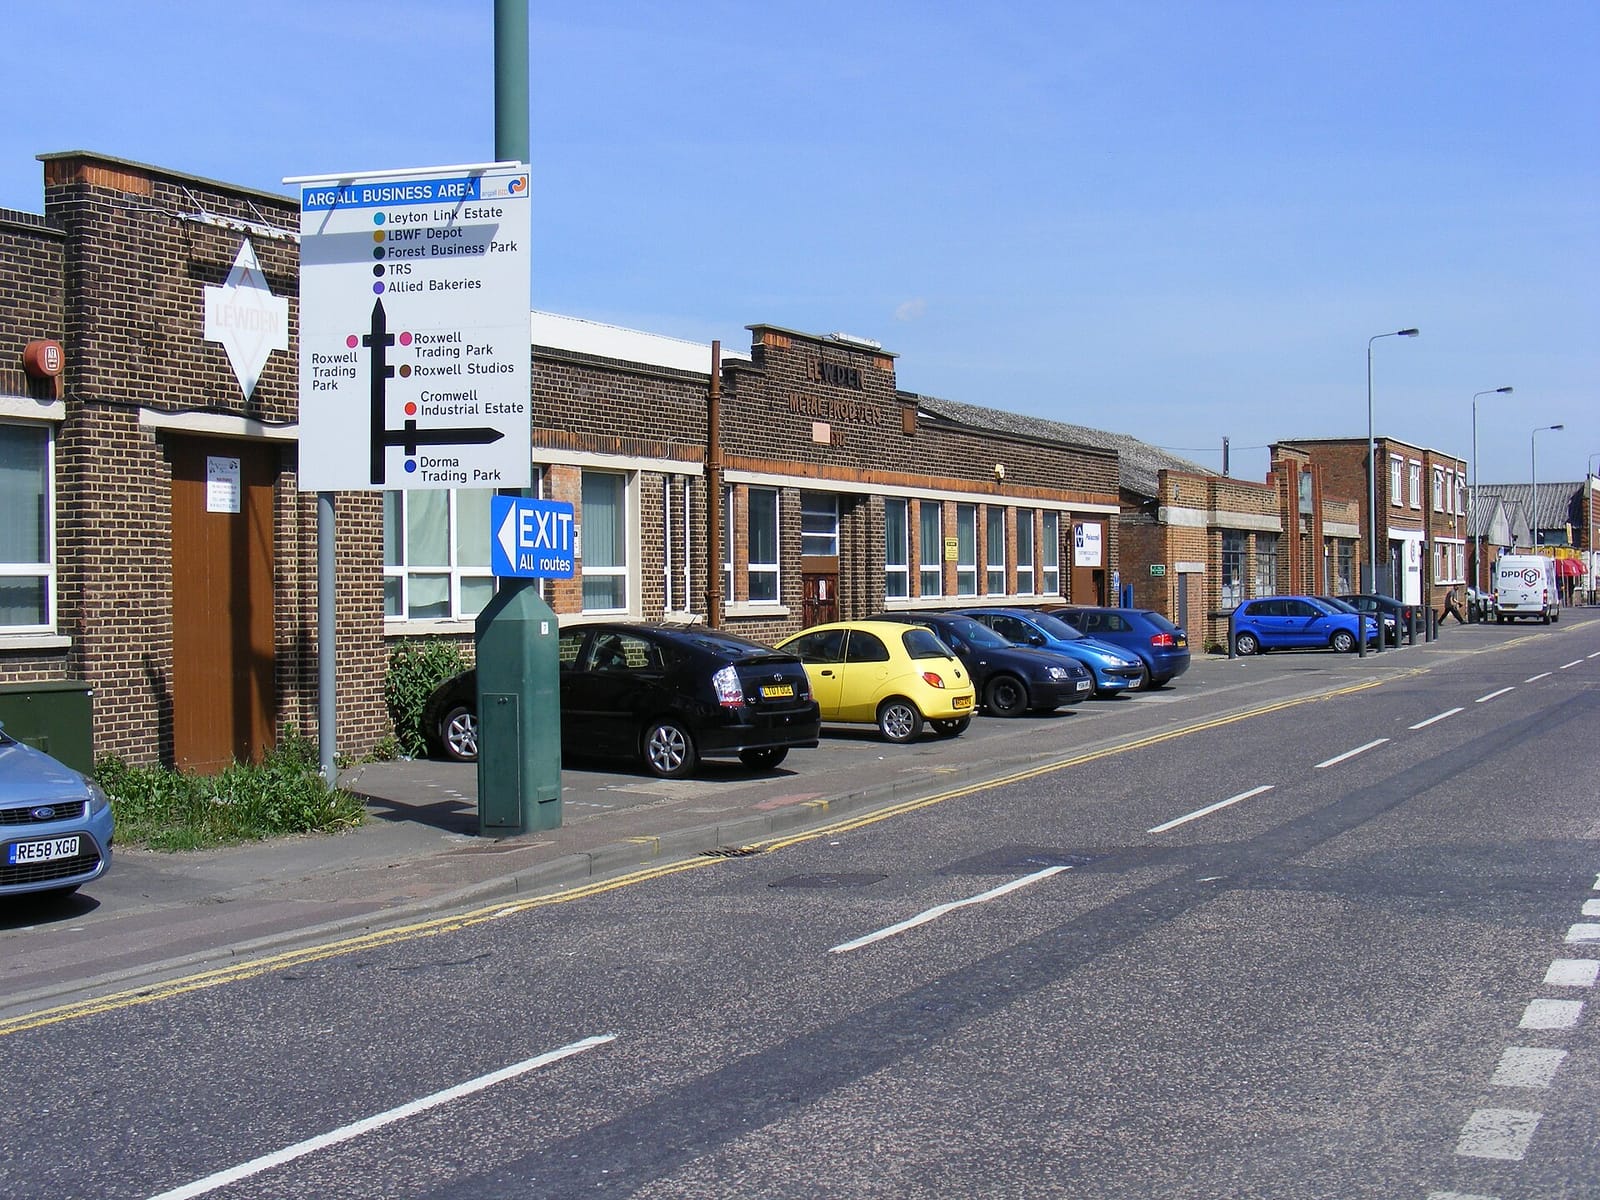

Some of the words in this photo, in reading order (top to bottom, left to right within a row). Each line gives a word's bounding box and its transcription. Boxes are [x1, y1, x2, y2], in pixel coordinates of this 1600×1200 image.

[307, 188, 358, 206] ARGALL
[362, 185, 432, 203] BUSINESS
[437, 182, 475, 197] AREA
[388, 211, 428, 225] Leyton
[434, 209, 458, 221] Link
[464, 207, 503, 219] Estate
[388, 229, 421, 241] LBWF
[427, 227, 463, 241] Depot
[388, 246, 426, 258] Forest
[431, 244, 485, 256] Business
[490, 241, 518, 252] Park
[388, 264, 412, 275] TRS
[388, 281, 423, 293] Allied
[429, 278, 482, 291] Bakeries
[216, 304, 278, 333] LEWDEN
[414, 332, 462, 344] Roxwell
[312, 352, 358, 364] Roxwell
[415, 346, 460, 359] Trading
[466, 344, 493, 355] Park
[313, 366, 356, 379] Trading
[414, 364, 462, 376] Roxwell
[467, 362, 514, 374] Studios
[313, 380, 338, 391] Park
[421, 390, 478, 402] Cromwell
[421, 404, 479, 416] Industrial
[485, 402, 524, 414] Estate
[420, 457, 459, 468] Dorma
[421, 470, 467, 483] Trading
[473, 469, 501, 481] Park
[519, 508, 572, 551] EXIT
[520, 554, 535, 570] All
[540, 556, 571, 572] routes
[1501, 570, 1520, 578] DPD
[18, 842, 52, 860] RE58
[55, 839, 77, 855] XGO
